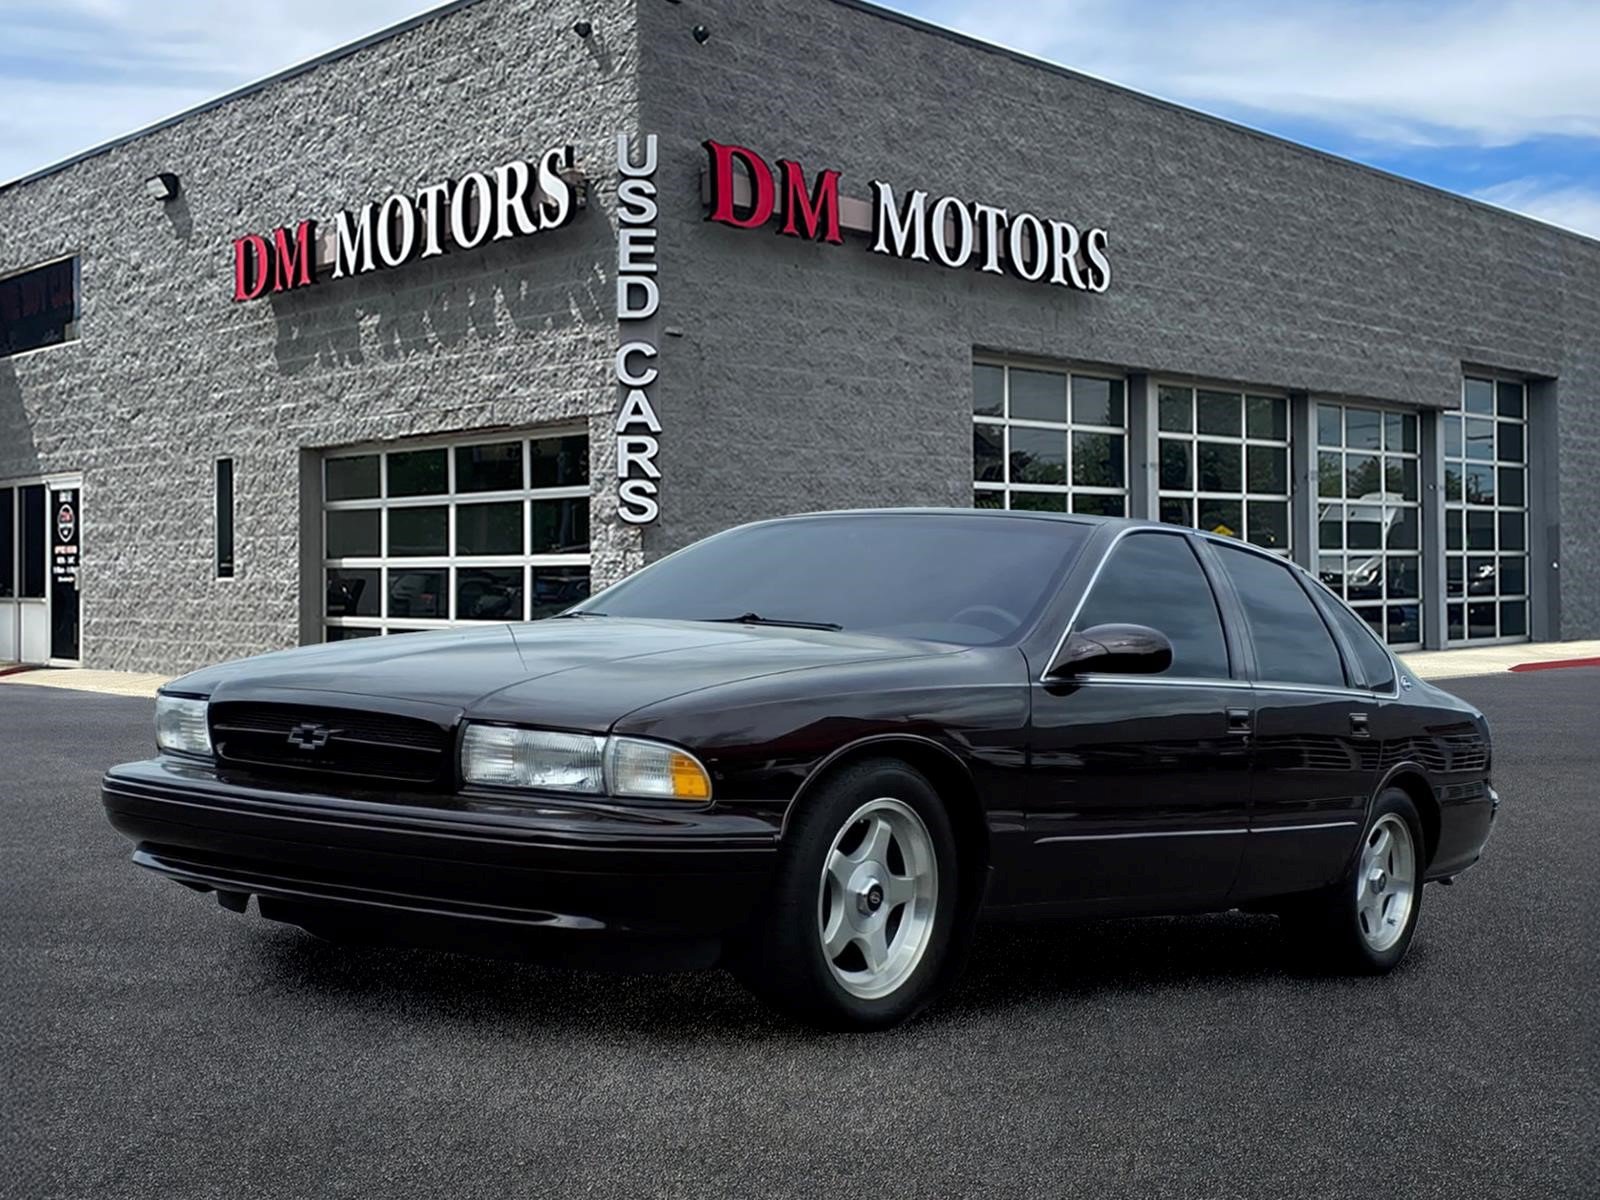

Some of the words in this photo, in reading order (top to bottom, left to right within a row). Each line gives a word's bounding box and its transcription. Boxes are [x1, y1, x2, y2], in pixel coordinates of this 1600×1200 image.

[233, 221, 314, 301] DM
[331, 145, 573, 279] MOTORS
[616, 134, 660, 320] USED
[702, 139, 845, 246] DM
[870, 179, 1112, 293] MOTORS
[615, 342, 662, 525] CARS
